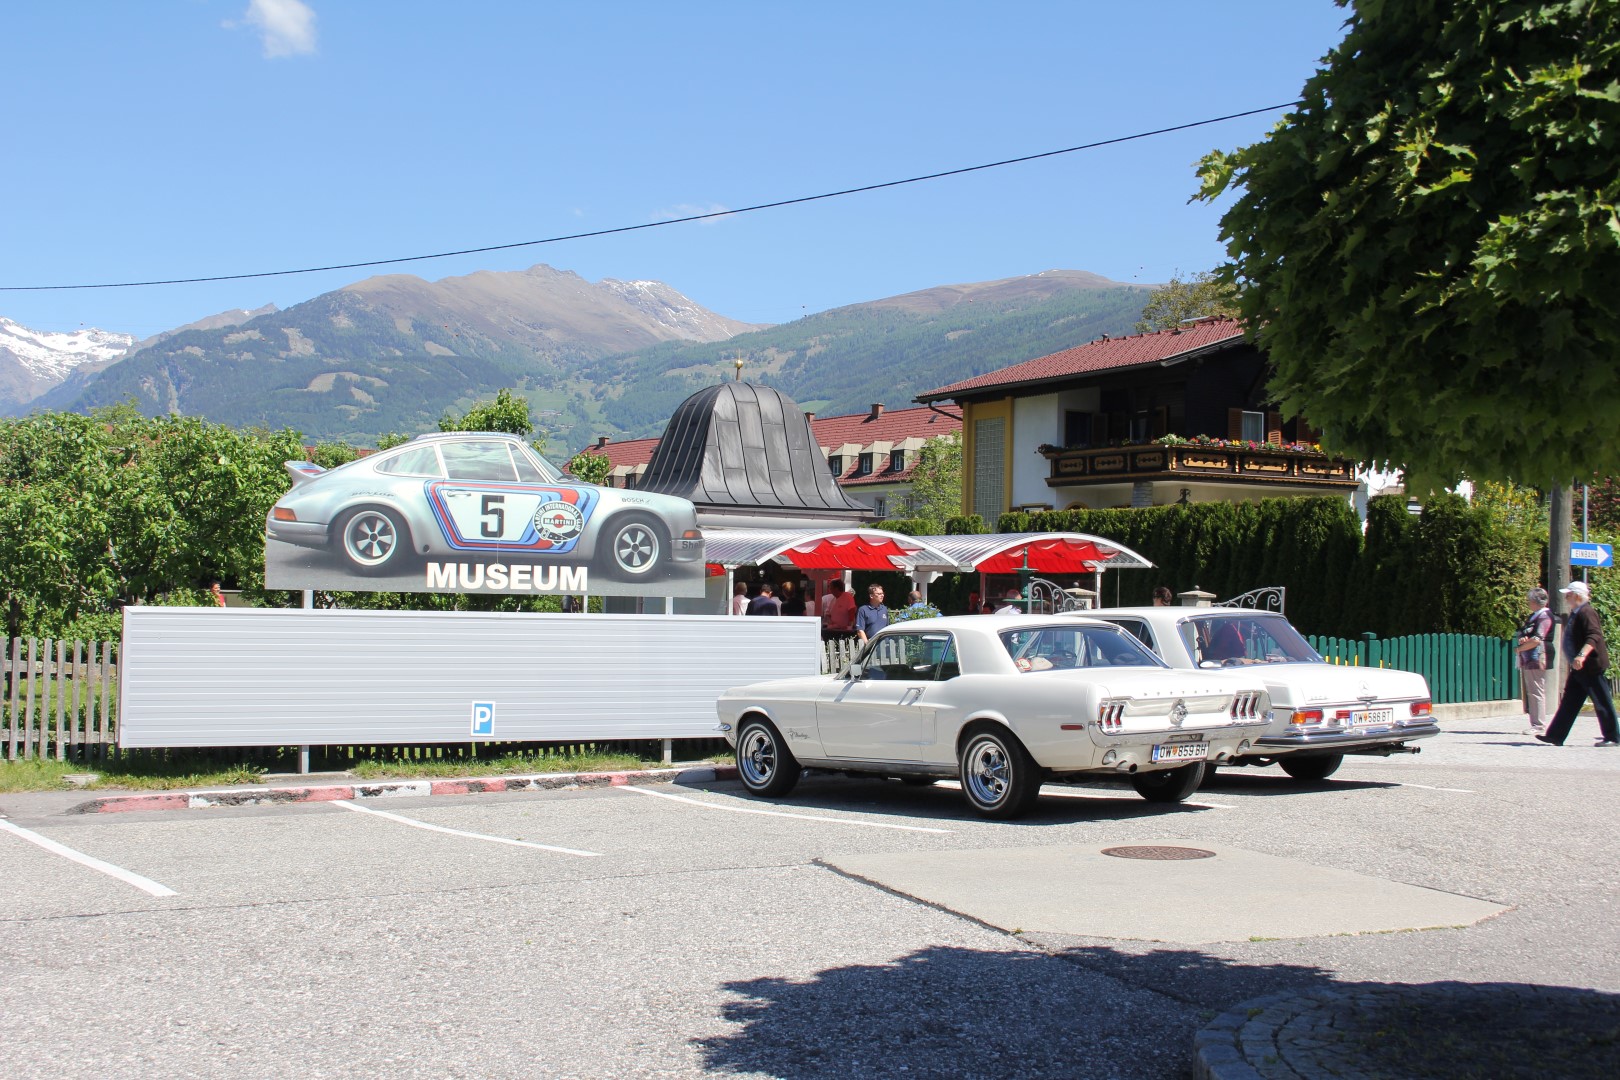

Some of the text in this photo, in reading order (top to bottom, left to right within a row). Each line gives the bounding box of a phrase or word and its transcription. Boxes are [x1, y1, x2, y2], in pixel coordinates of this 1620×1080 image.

[481, 495, 505, 538] 5
[544, 518, 574, 526] MARTINI
[1575, 550, 1597, 558] EINBAHN
[426, 562, 588, 591] MUSEUM
[475, 706, 491, 731] P
[1368, 712, 1381, 723] 586
[1382, 711, 1391, 722] BT
[1178, 745, 1194, 757] 859
[1195, 744, 1207, 756] BH
